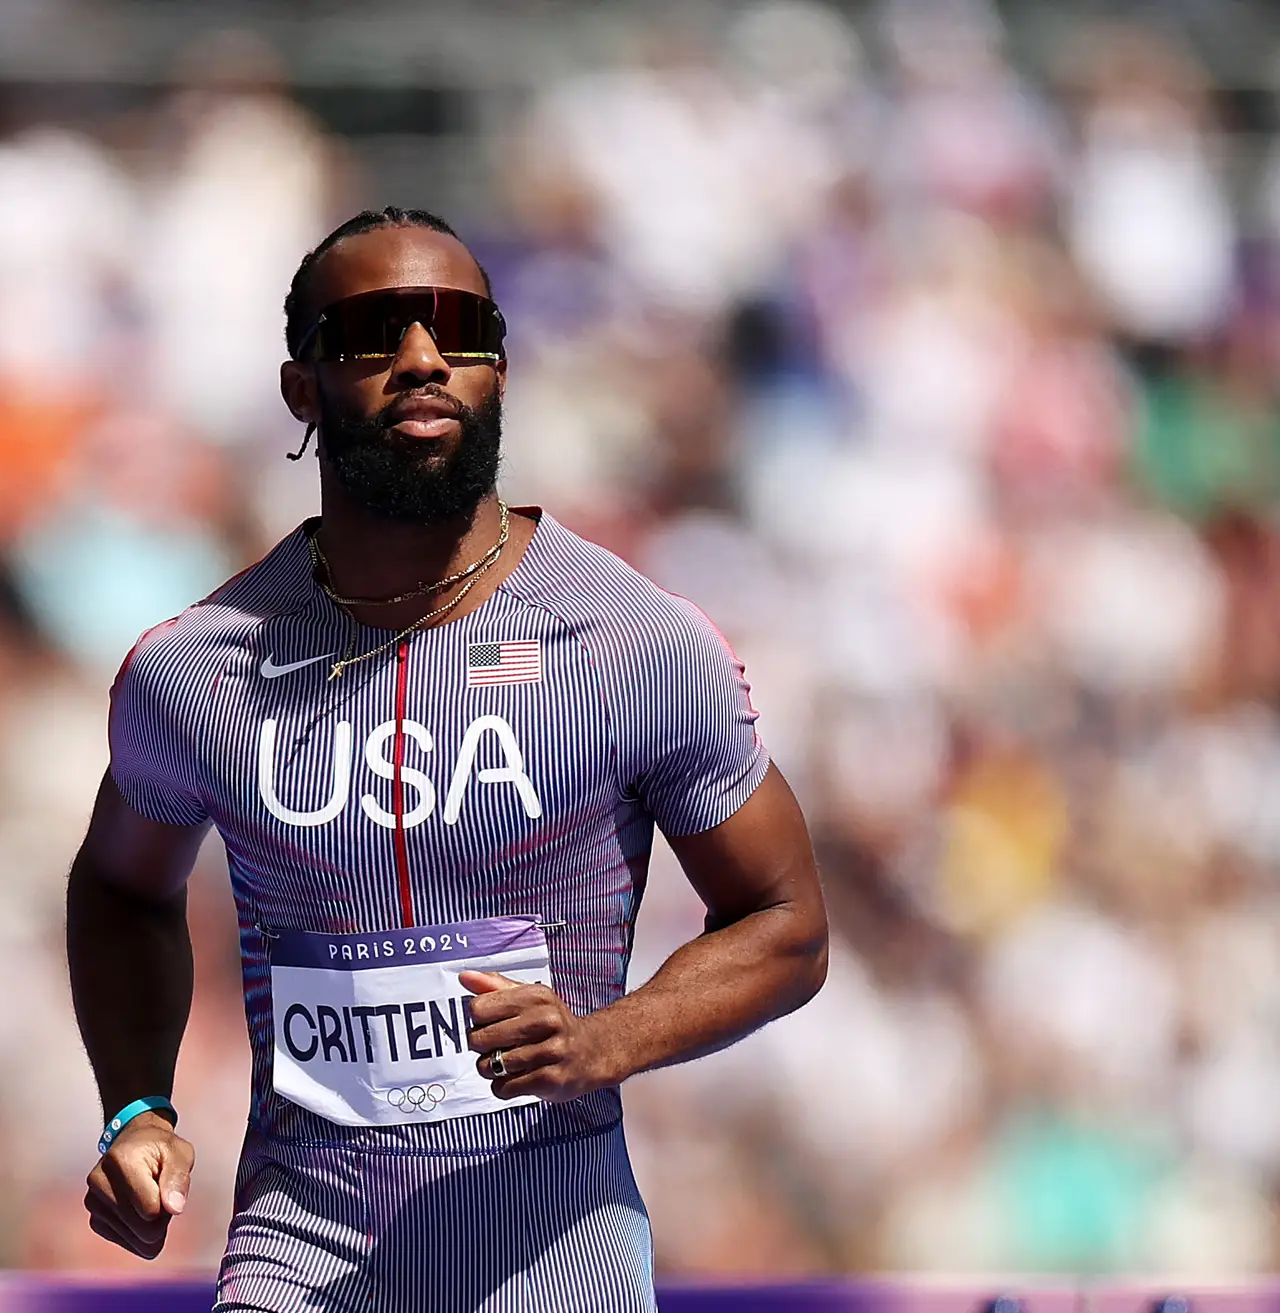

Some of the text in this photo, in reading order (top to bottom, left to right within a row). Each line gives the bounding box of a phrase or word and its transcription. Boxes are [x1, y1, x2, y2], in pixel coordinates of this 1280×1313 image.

[258, 714, 543, 830] USA
[403, 932, 468, 955] 2024
[283, 981, 542, 1064] CRITTEN
